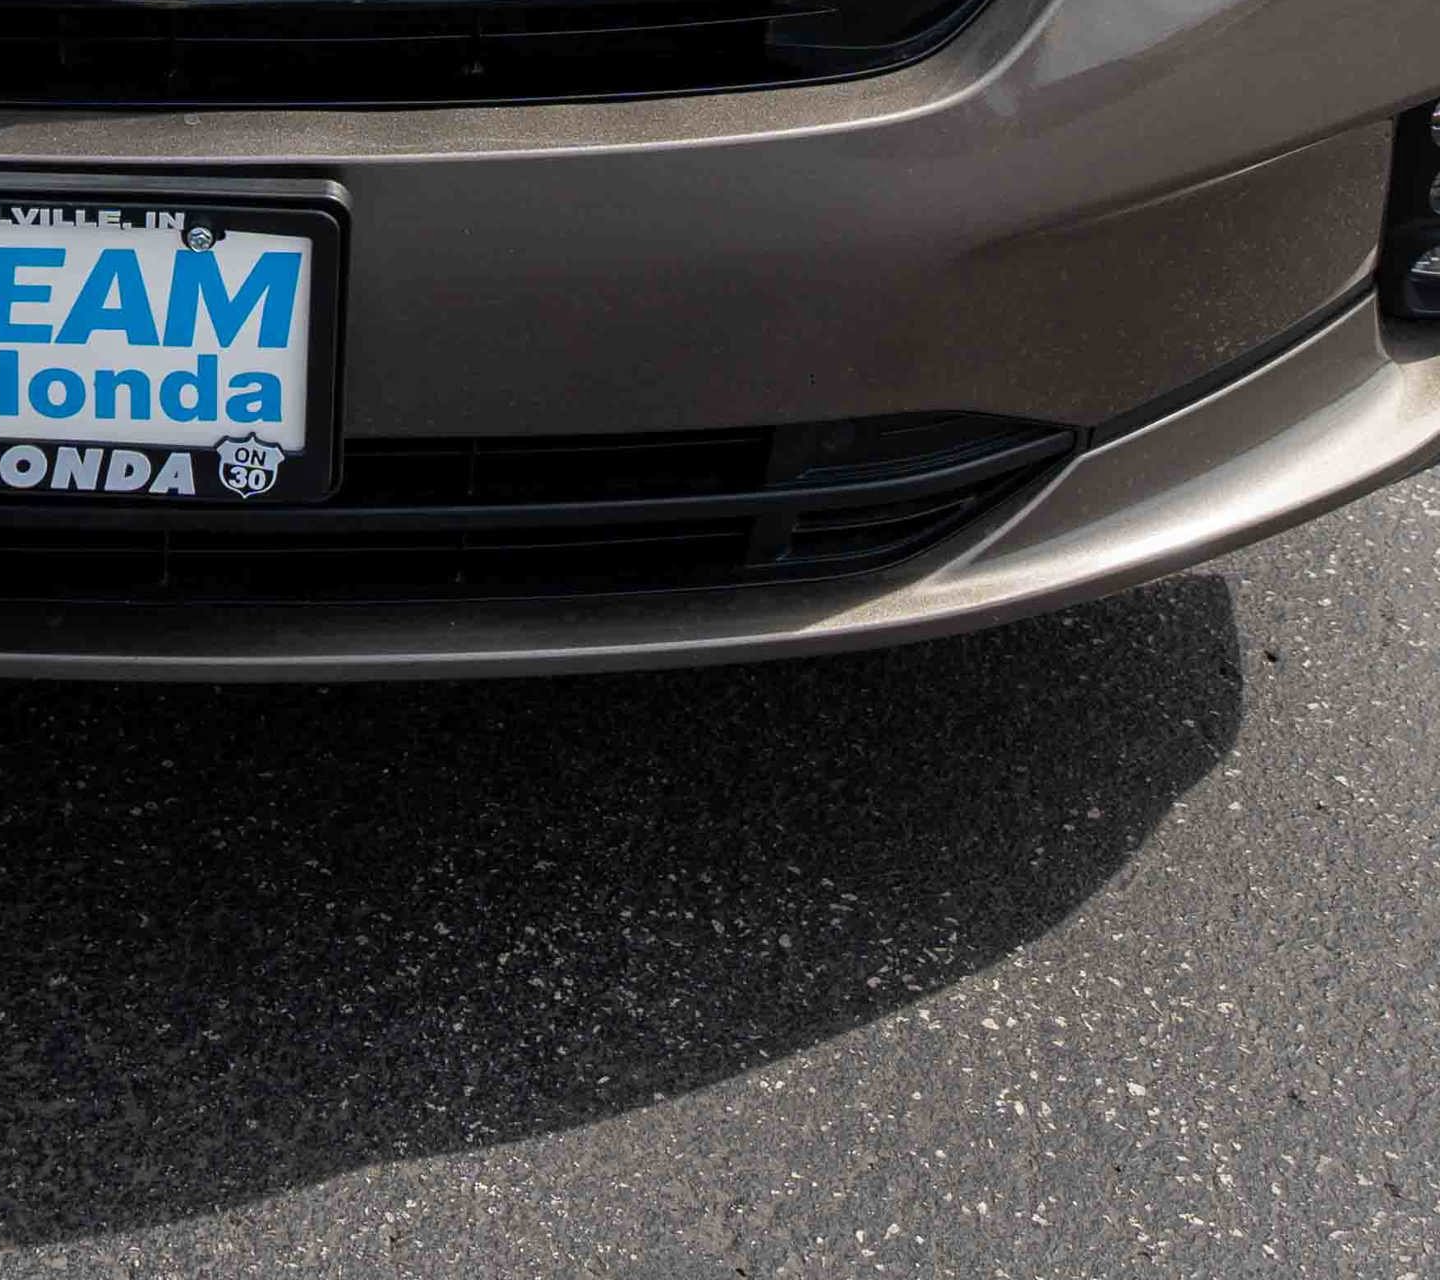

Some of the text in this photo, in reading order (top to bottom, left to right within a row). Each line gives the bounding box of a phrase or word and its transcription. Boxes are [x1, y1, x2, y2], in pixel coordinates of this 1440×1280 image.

[145, 211, 185, 231] IN
[234, 447, 266, 466] ON
[229, 466, 266, 490] 30
